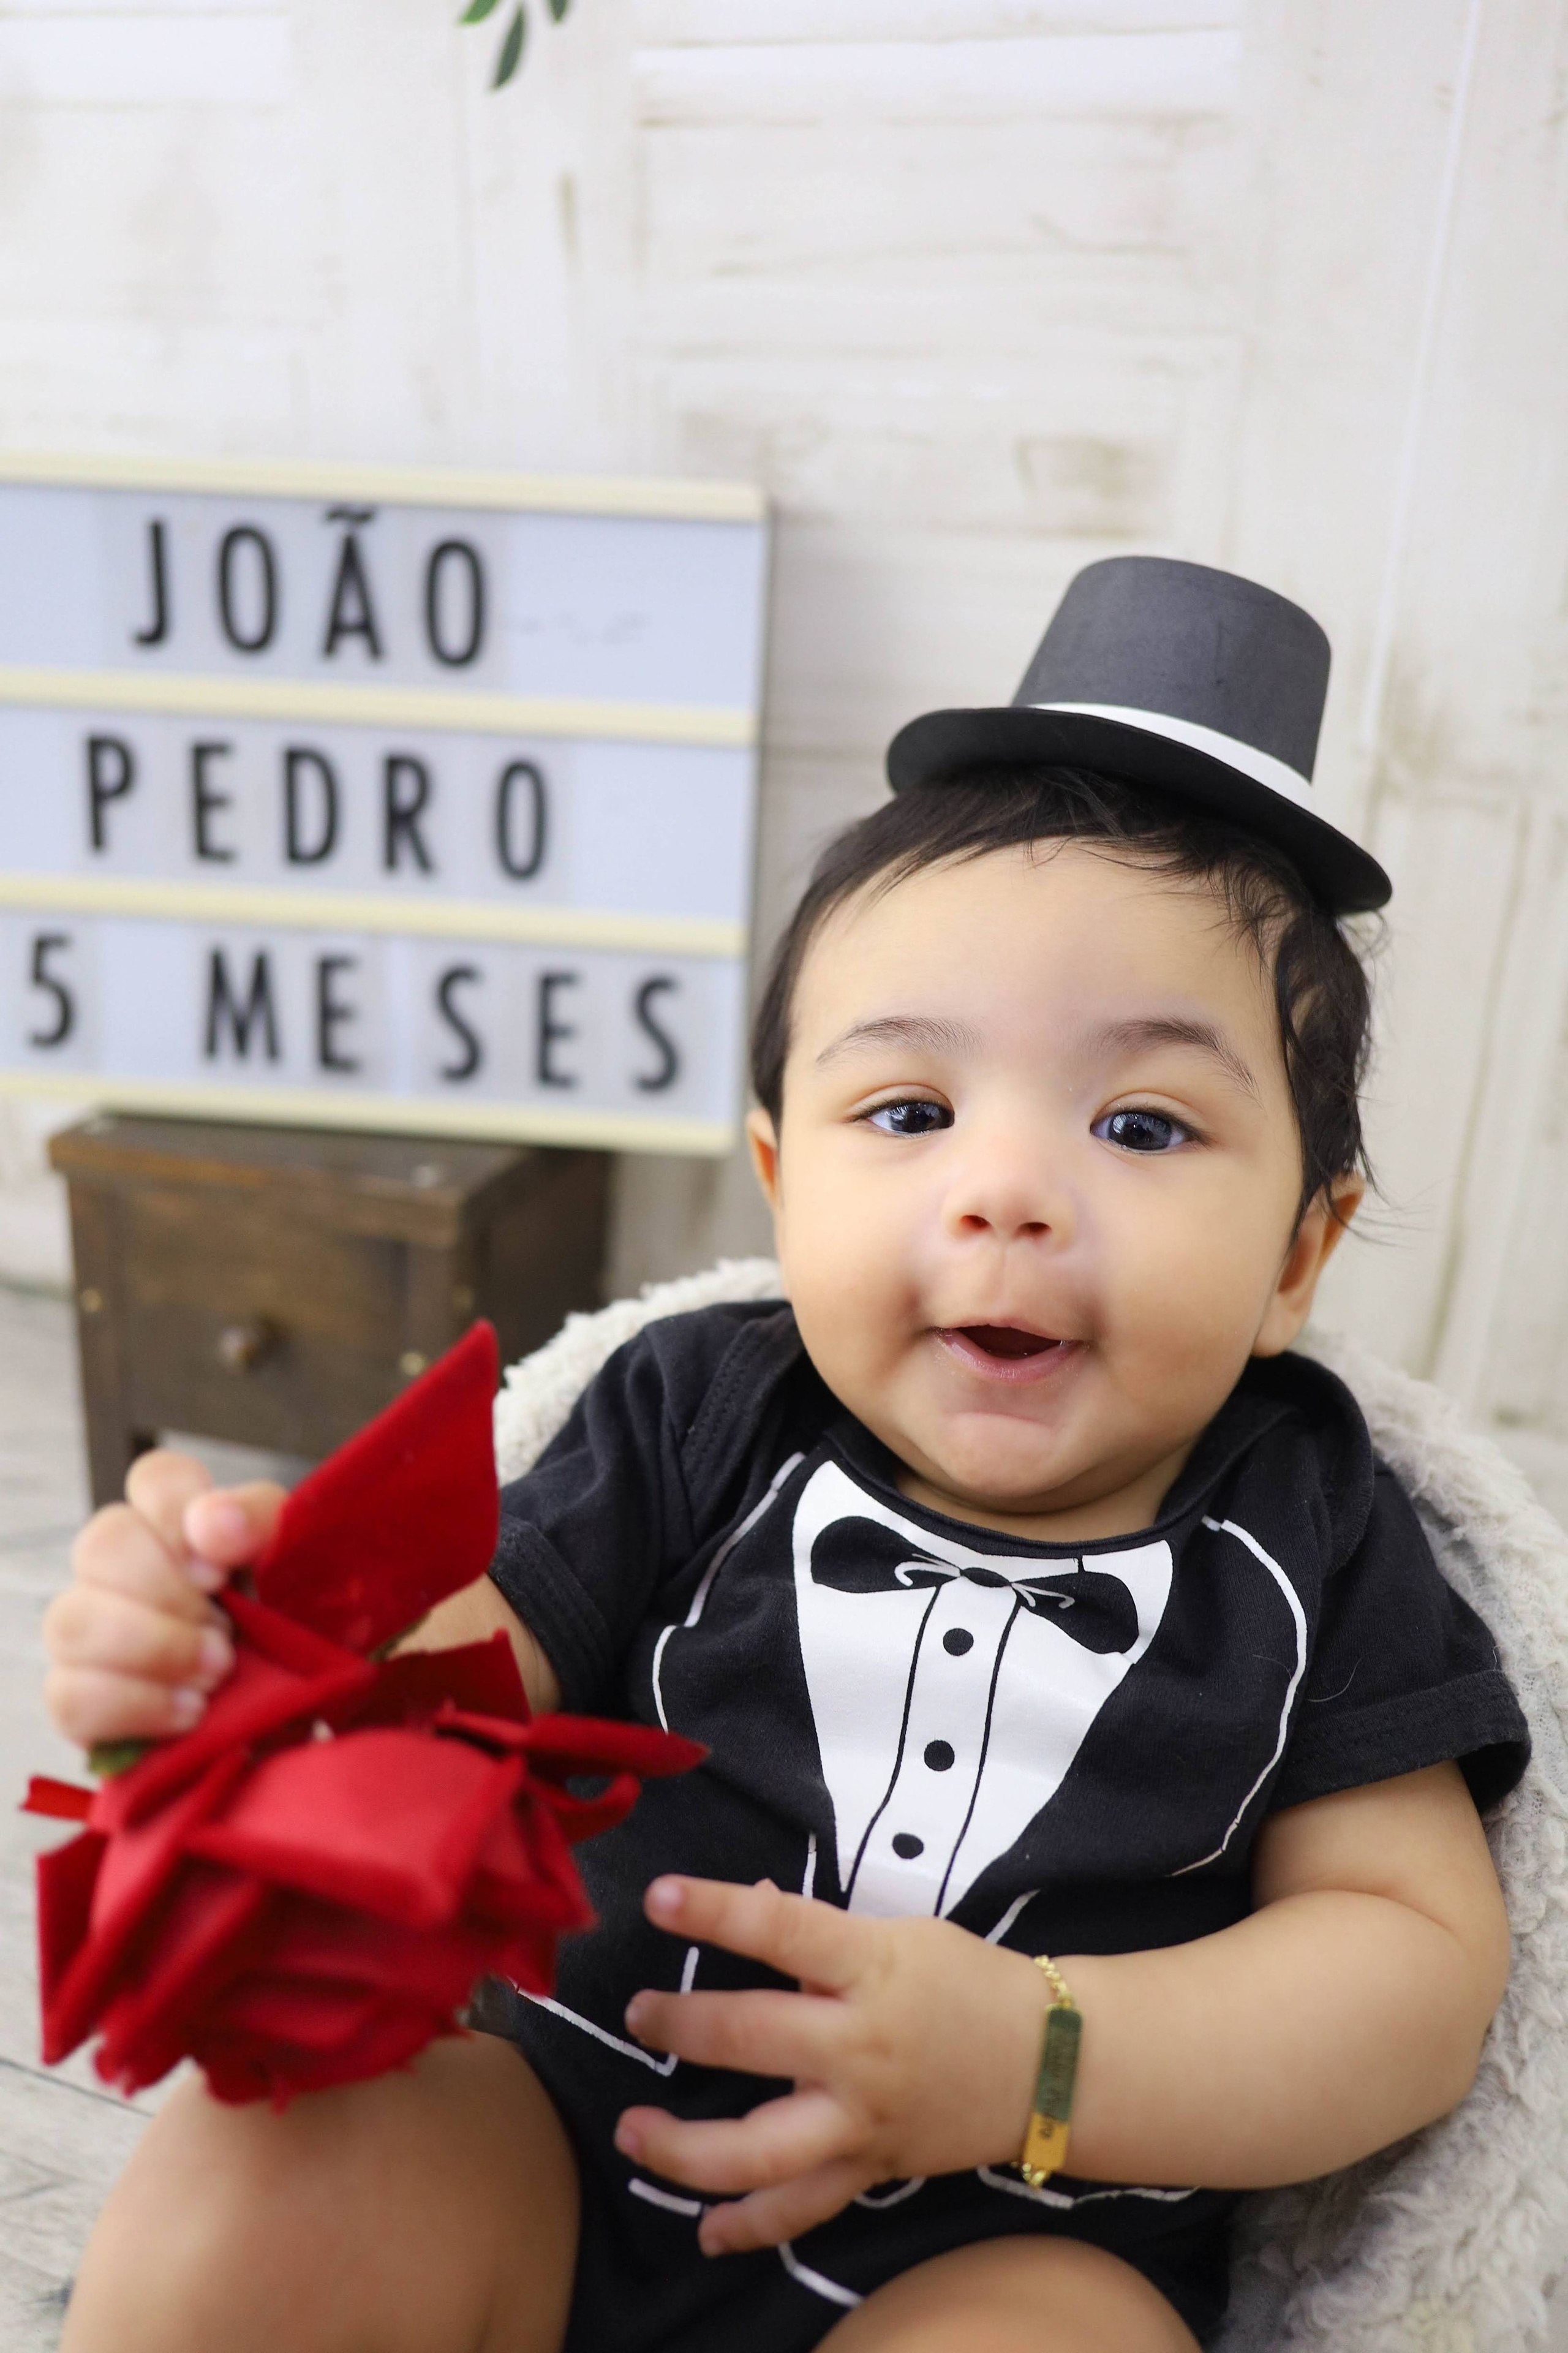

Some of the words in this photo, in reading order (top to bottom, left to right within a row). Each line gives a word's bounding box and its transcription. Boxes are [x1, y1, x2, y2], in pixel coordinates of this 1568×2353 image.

[134, 505, 488, 670] JOÃO
[85, 733, 549, 882] PEDRO
[29, 933, 77, 1049] 5
[203, 948, 681, 1094] MESES
